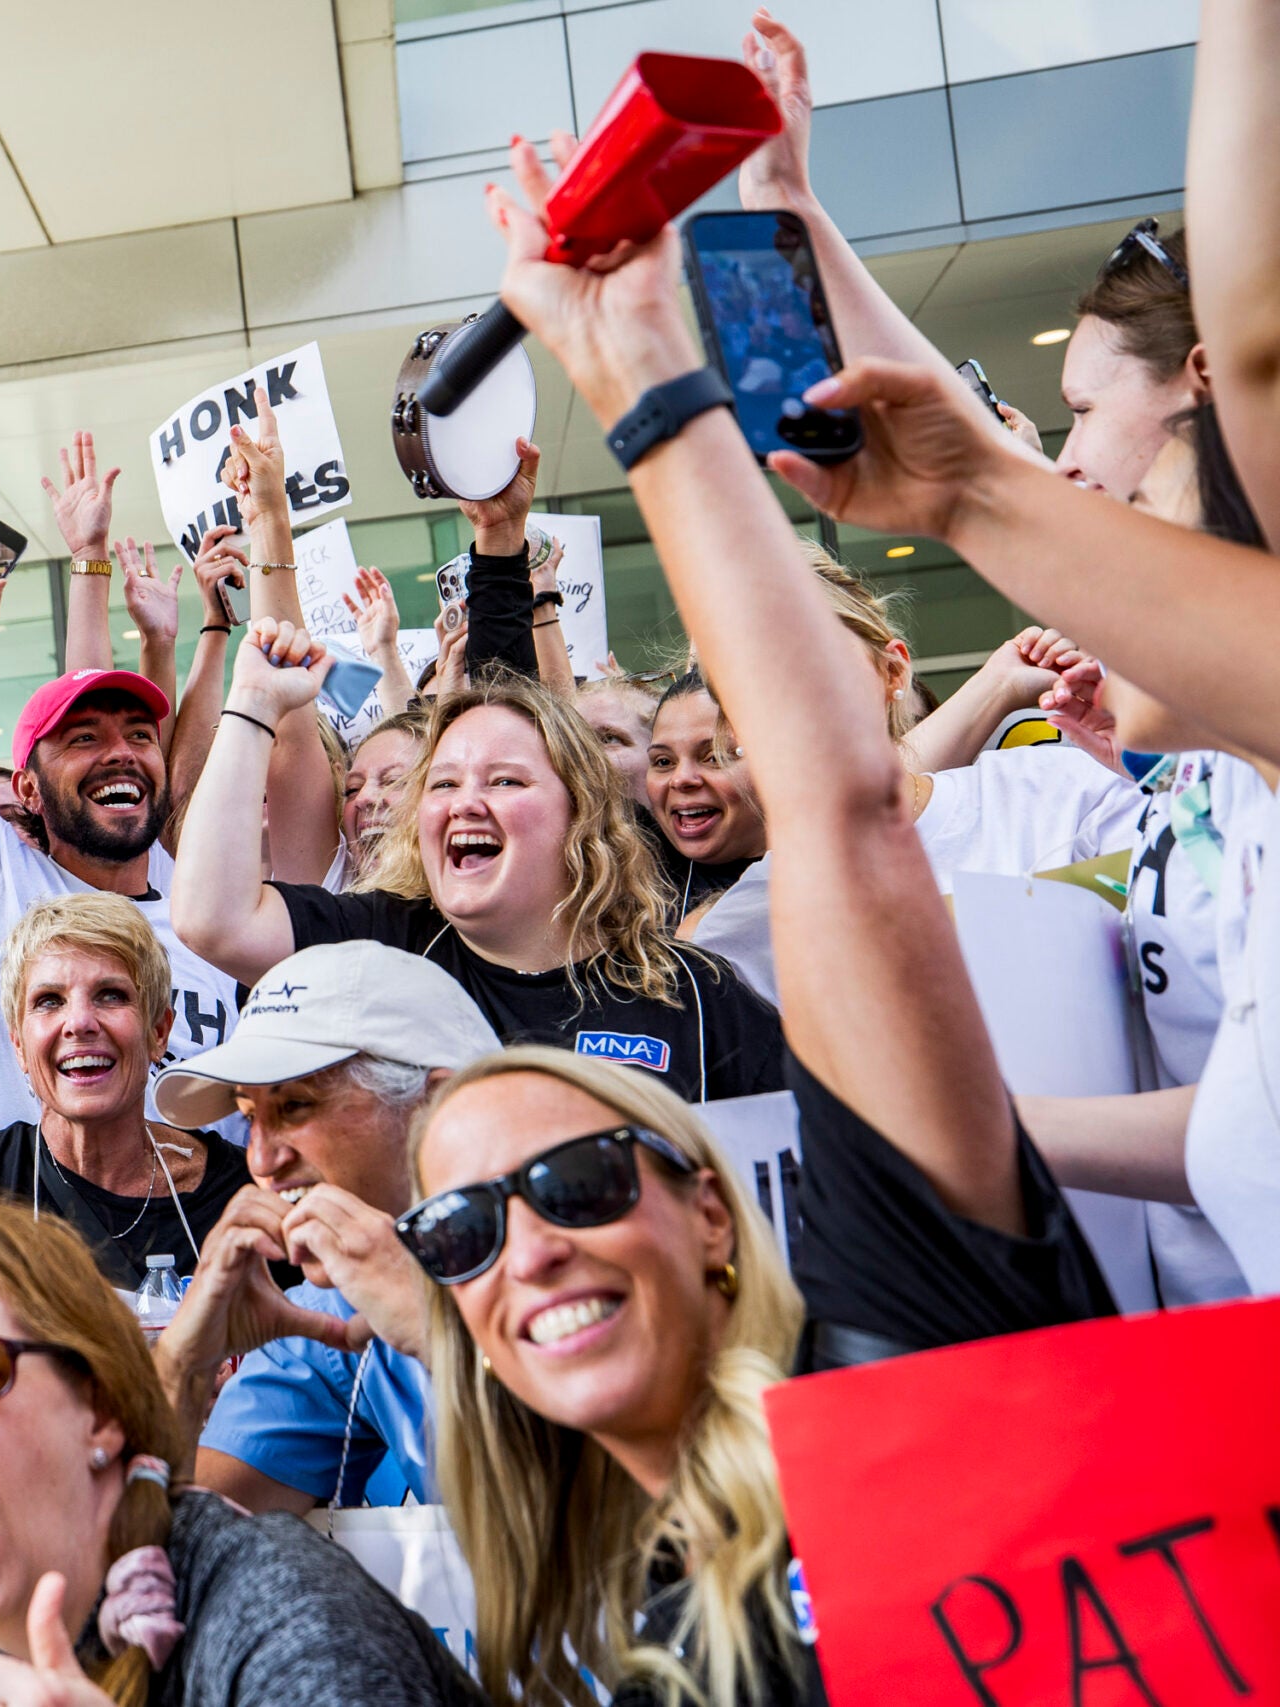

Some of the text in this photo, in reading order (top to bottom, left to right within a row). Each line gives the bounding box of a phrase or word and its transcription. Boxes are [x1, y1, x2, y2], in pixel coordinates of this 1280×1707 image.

[159, 360, 298, 465] HONK
[557, 578, 593, 613] sing
[582, 1037, 653, 1060] MNA
